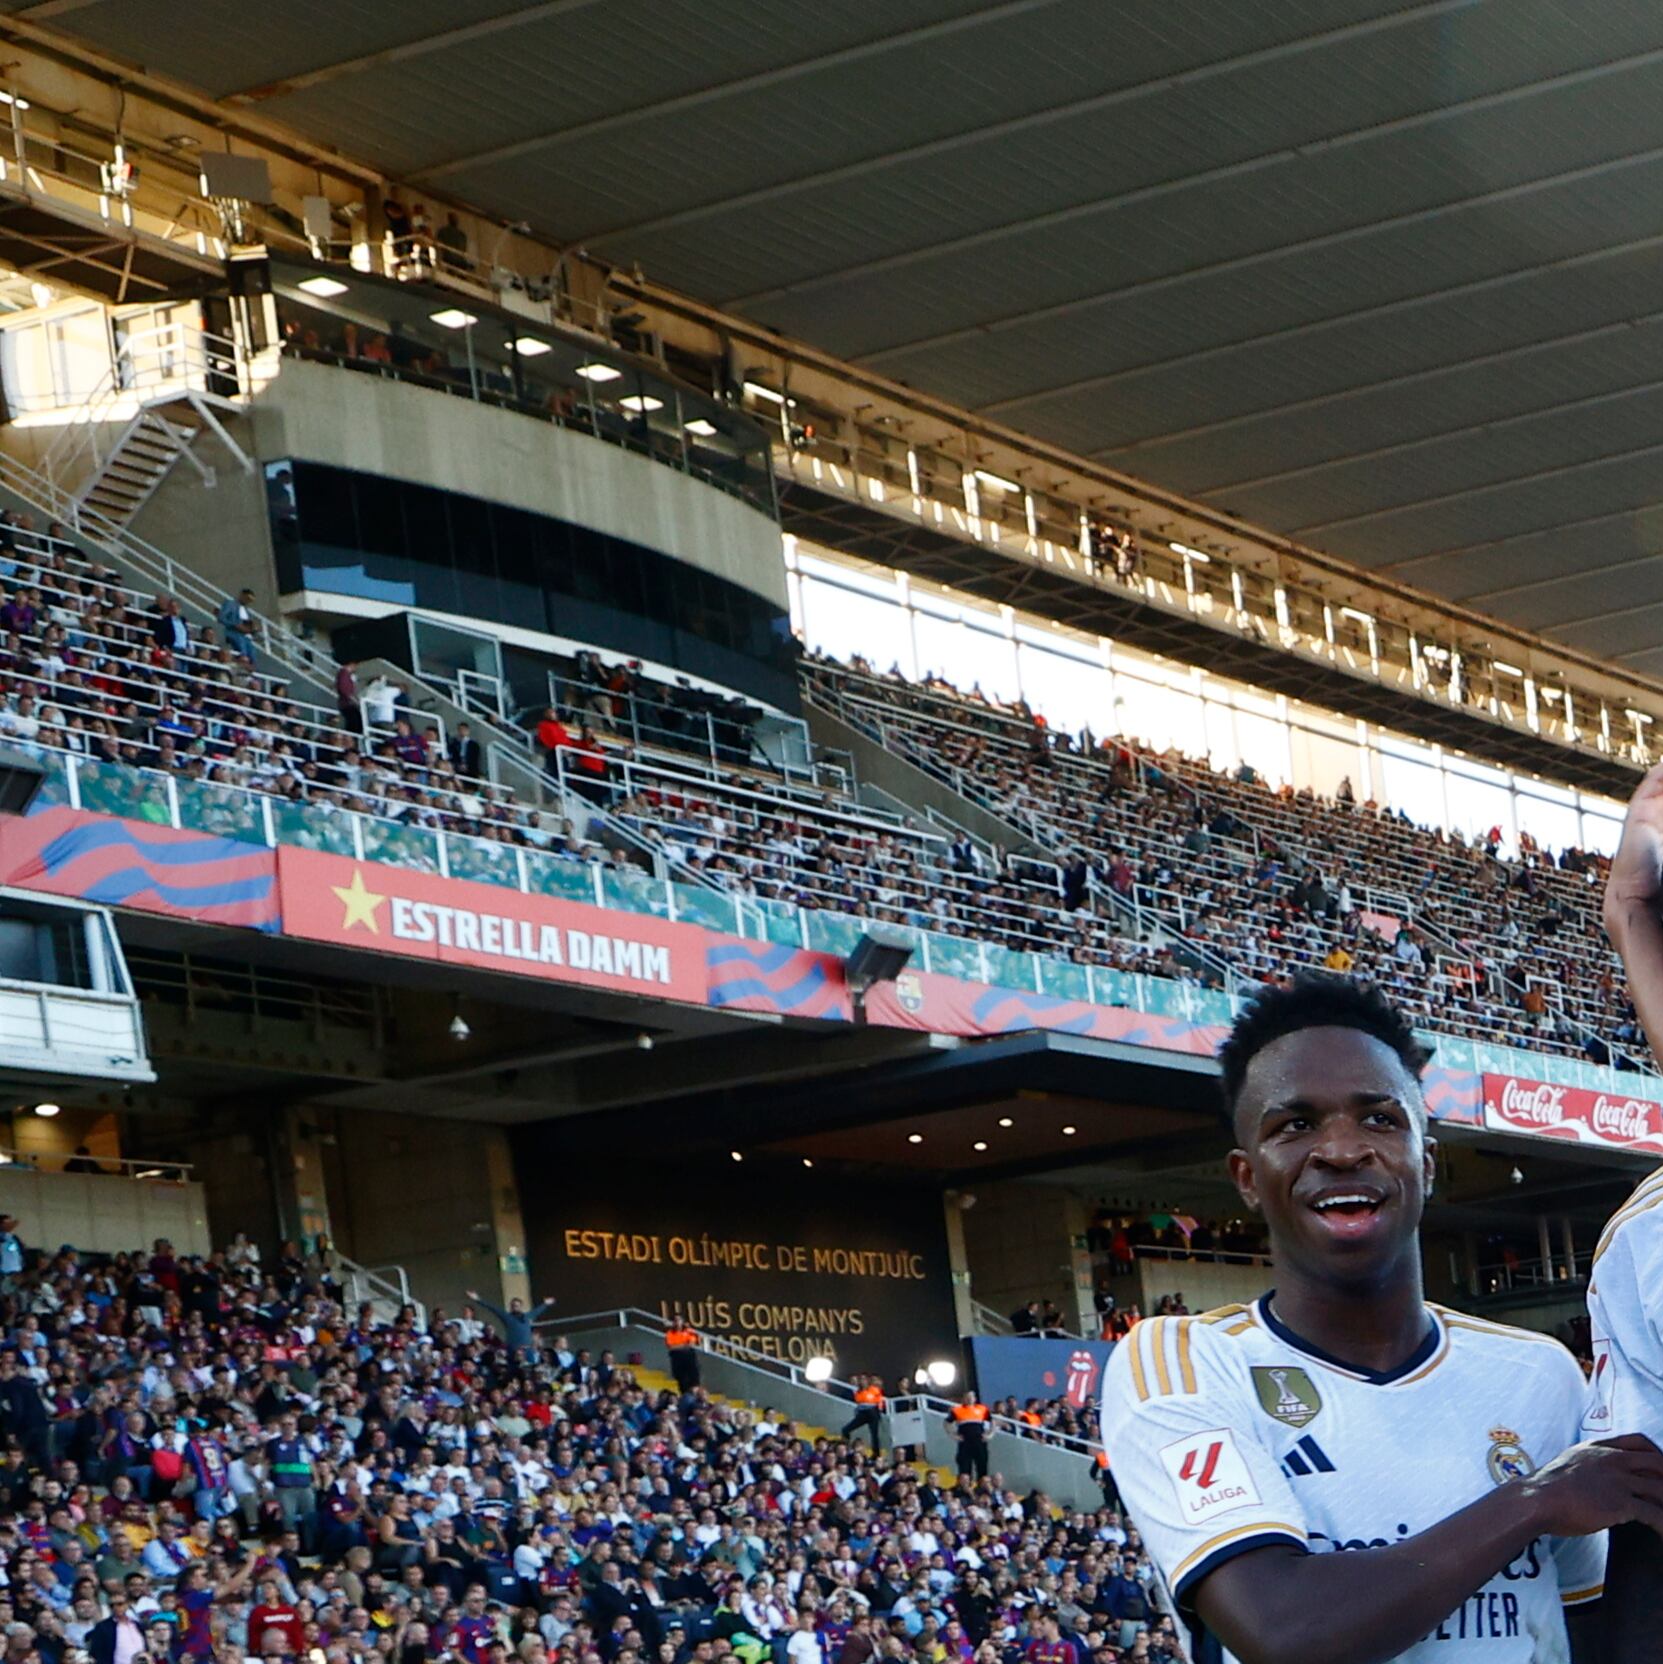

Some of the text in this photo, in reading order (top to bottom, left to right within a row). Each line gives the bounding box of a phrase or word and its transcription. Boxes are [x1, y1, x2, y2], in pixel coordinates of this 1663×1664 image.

[391, 896, 671, 984] ESTRELLA DAMM
[565, 1230, 925, 1280] ESTADI OLÍMPIC DE MONTJUÏC
[739, 1303, 864, 1335] COMPANYS
[702, 1335, 838, 1362] ARCELONA
[1190, 1485, 1248, 1512] LALIGA
